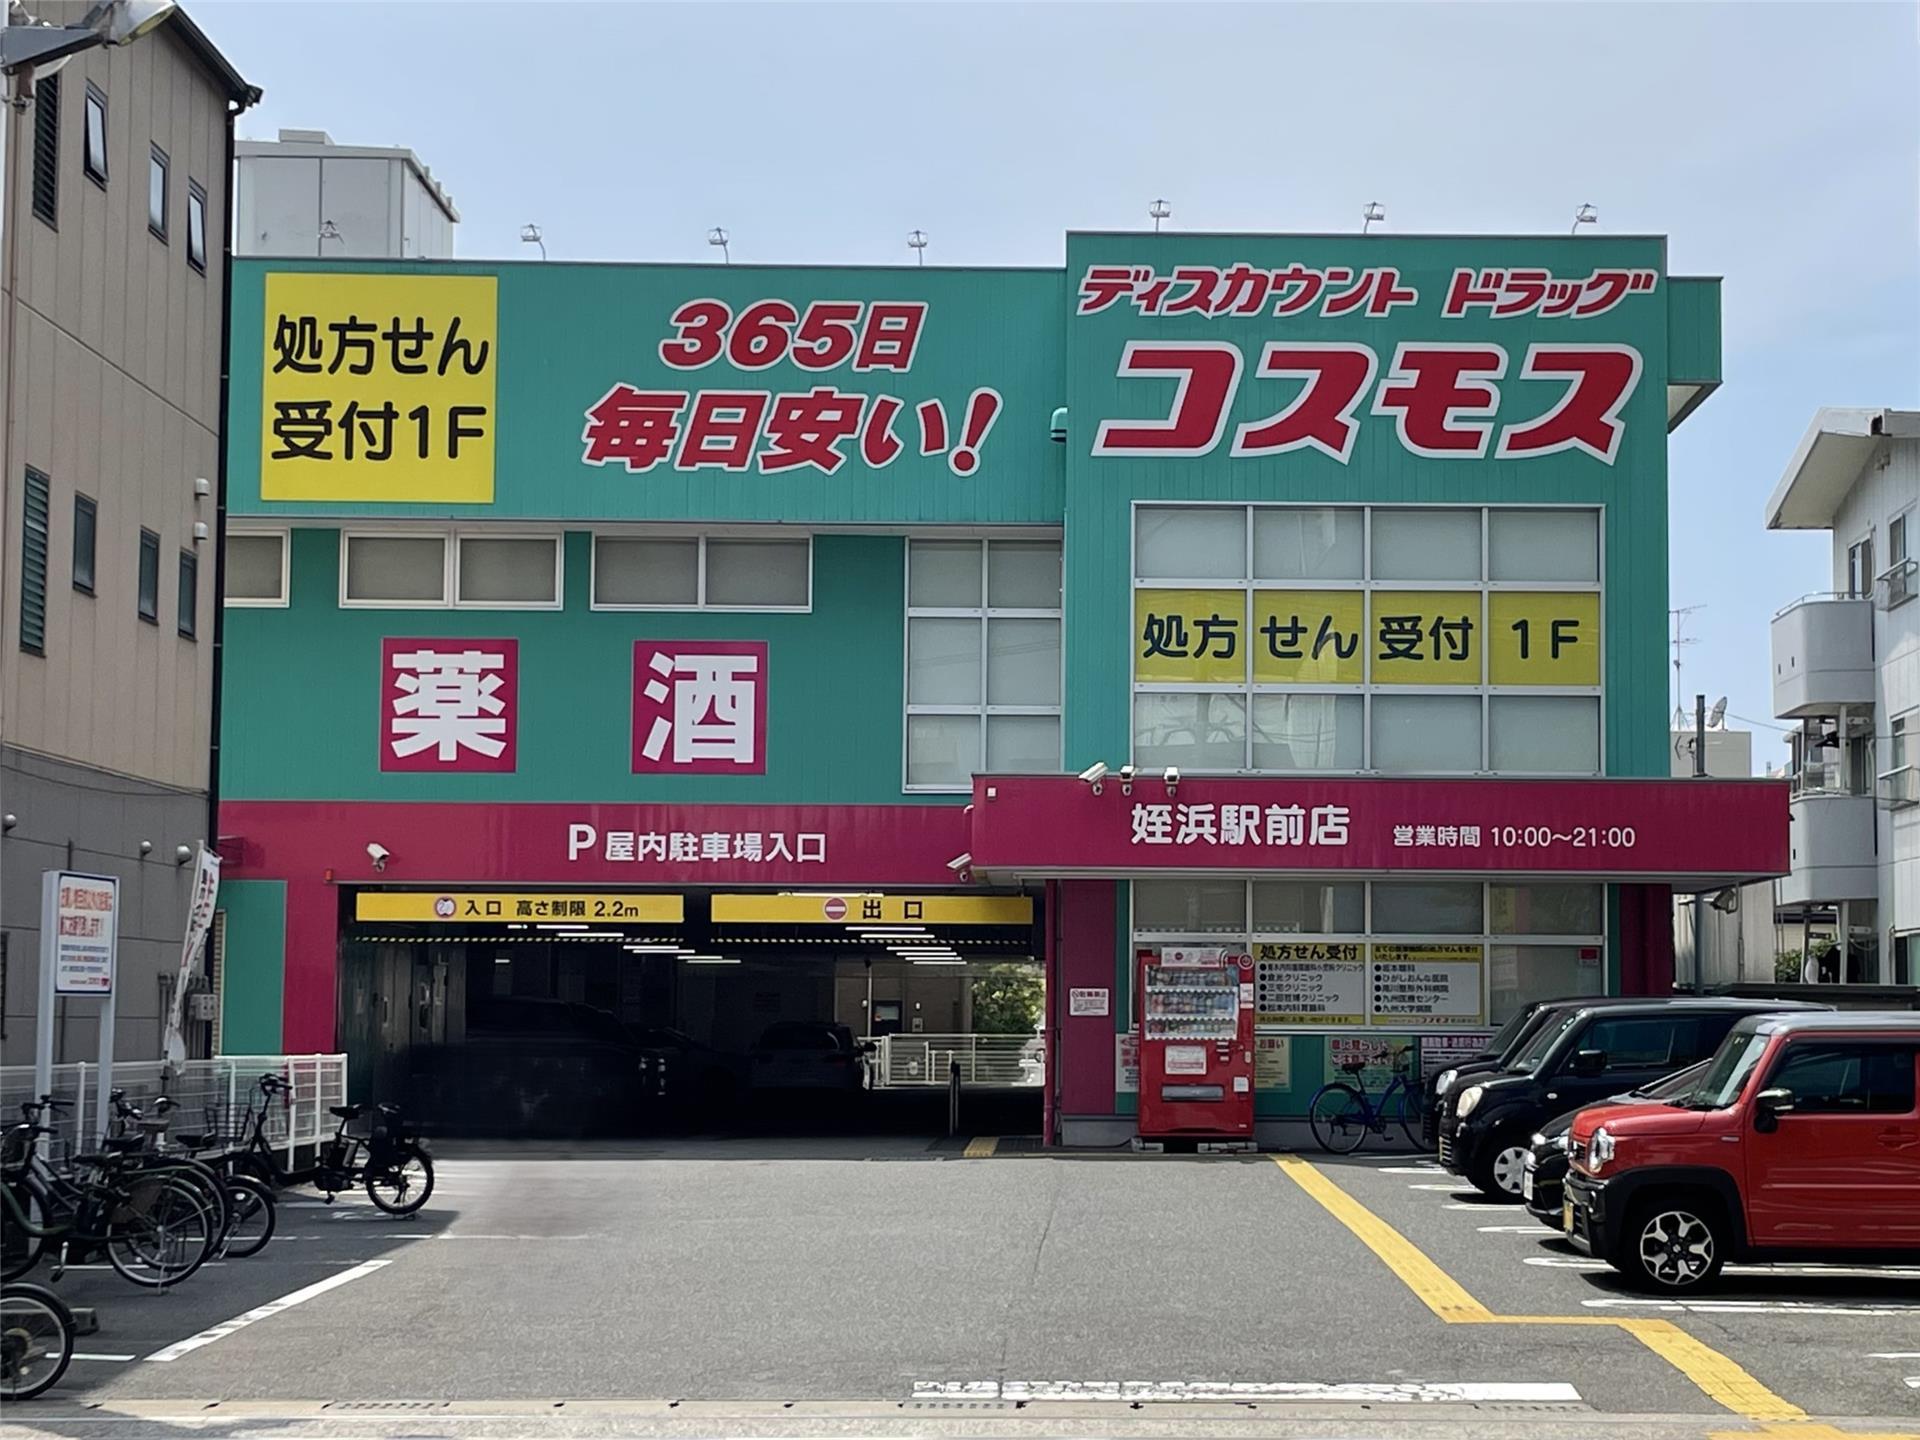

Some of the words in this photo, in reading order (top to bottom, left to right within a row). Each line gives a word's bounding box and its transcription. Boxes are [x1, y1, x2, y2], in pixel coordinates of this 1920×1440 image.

[1076, 262, 1419, 320] ディスカウント
[1441, 266, 1659, 319] ドラッグ
[272, 313, 490, 376] 処方せん
[659, 298, 929, 372] 365日
[270, 398, 489, 461] 受付1F
[1091, 340, 1643, 466] コスモス
[391, 649, 508, 763] 薬
[641, 651, 759, 764] 酒
[568, 823, 597, 861] P
[604, 831, 826, 863] 屋内駐車場入口
[1131, 802, 1350, 847] 姪浜駅前店
[1392, 824, 1481, 848] 営業時間
[464, 899, 502, 917] 入口
[516, 899, 587, 917] 高さ制限
[594, 901, 640, 918] 2.2m
[1260, 944, 1358, 960] 処方せん受付
